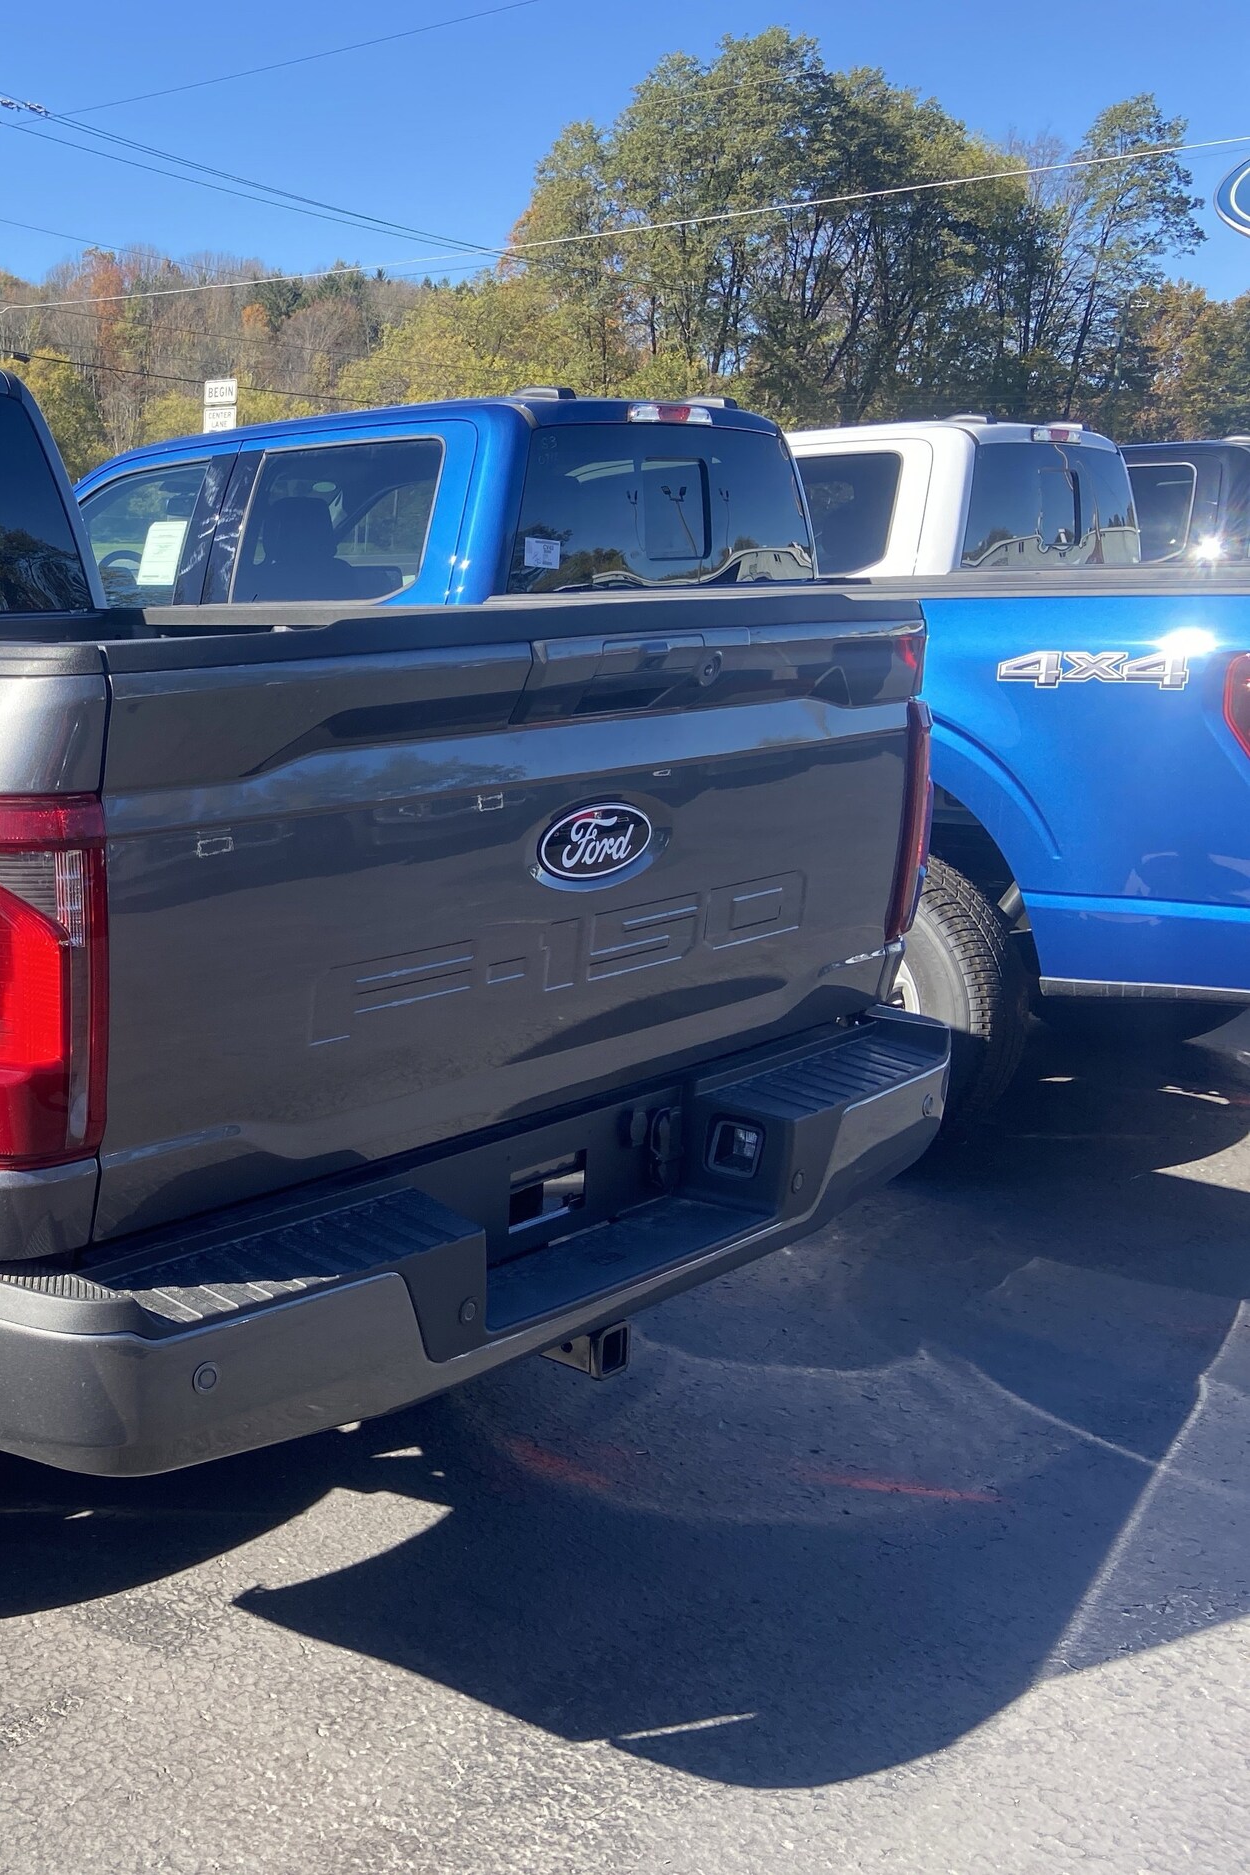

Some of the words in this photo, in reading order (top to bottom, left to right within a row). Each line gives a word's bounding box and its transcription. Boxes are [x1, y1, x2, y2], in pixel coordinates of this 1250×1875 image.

[208, 386, 234, 398] BEGIN
[208, 411, 232, 420] CENTER
[211, 420, 228, 428] LANE
[562, 816, 635, 868] Ford
[308, 870, 808, 1047] F-150
